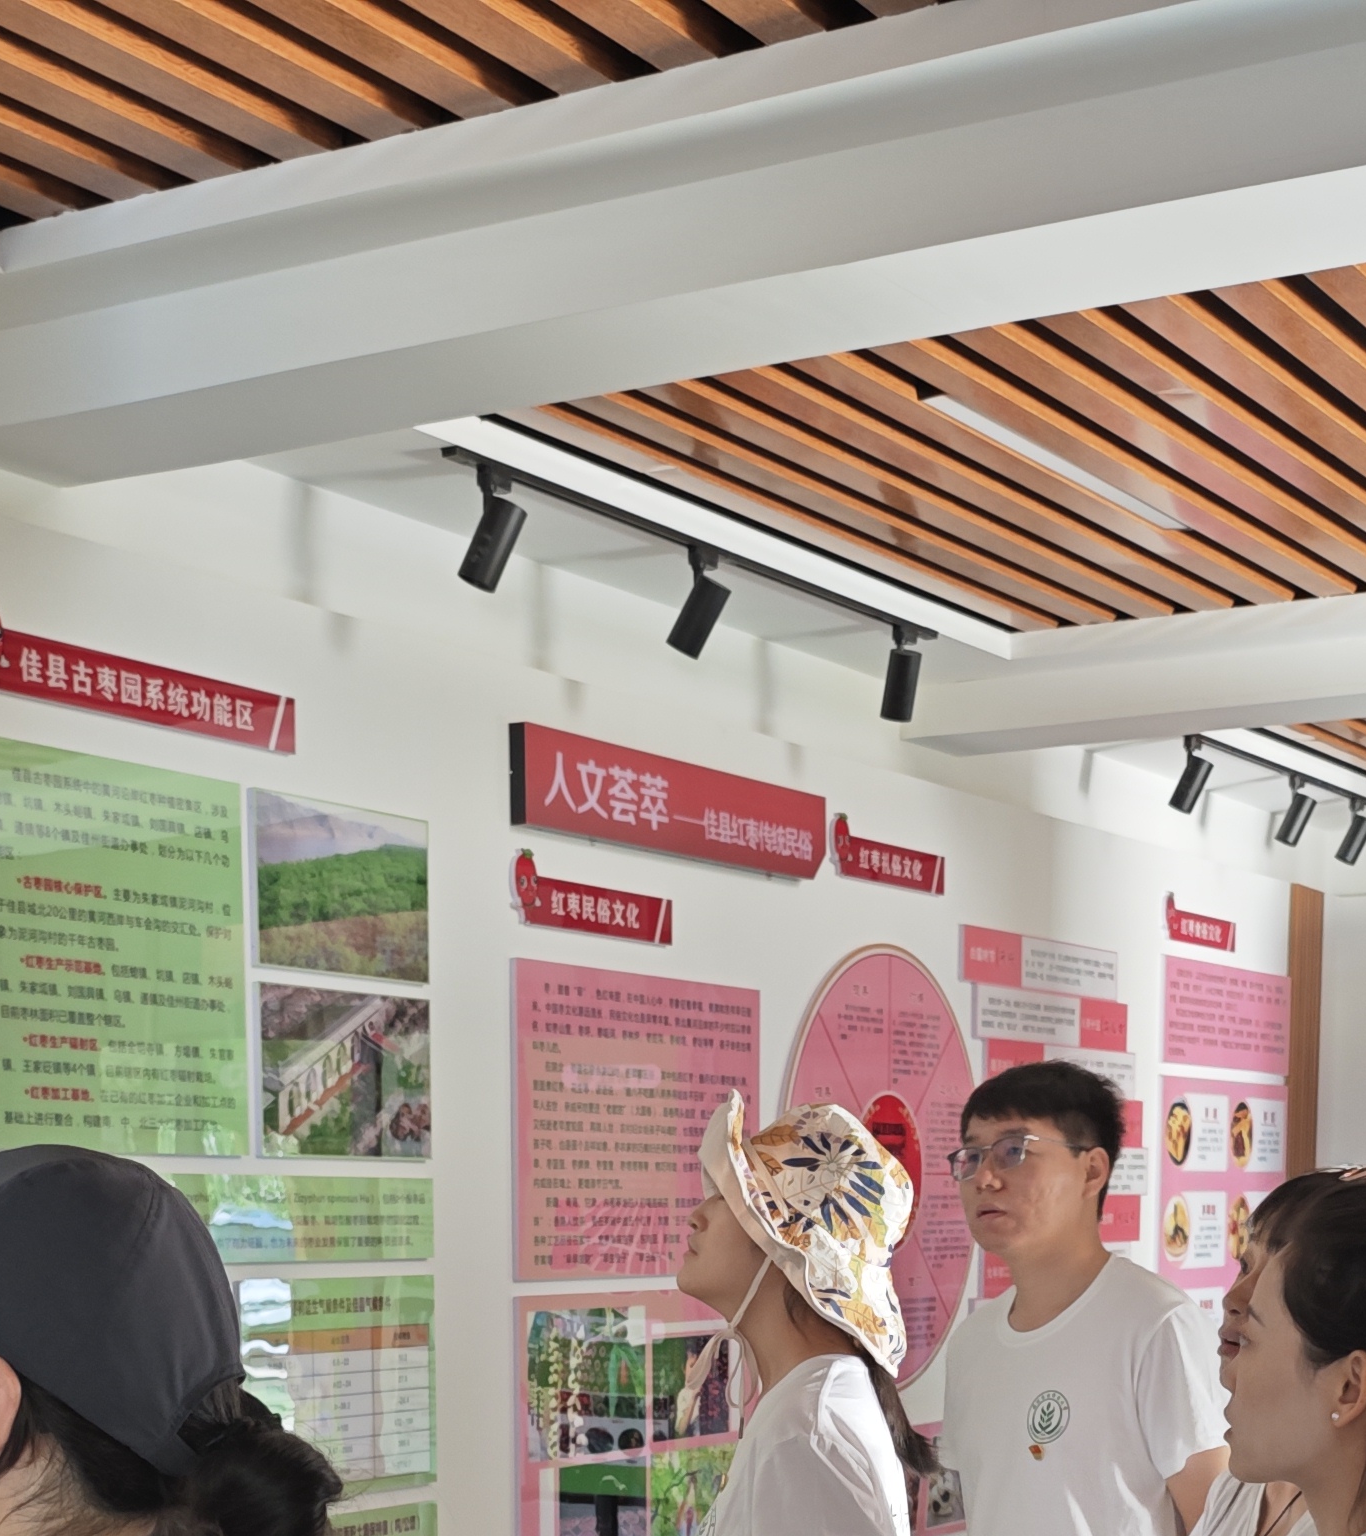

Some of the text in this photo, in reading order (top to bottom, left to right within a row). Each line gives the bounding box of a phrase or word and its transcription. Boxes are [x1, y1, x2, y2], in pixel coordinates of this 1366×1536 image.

[19, 647, 255, 731] 佳县古枣园系统功能区
[544, 751, 669, 831] 人文荟萃
[858, 847, 923, 881] 红枣礼俗文化
[550, 889, 640, 930] 红枣民俗文化
